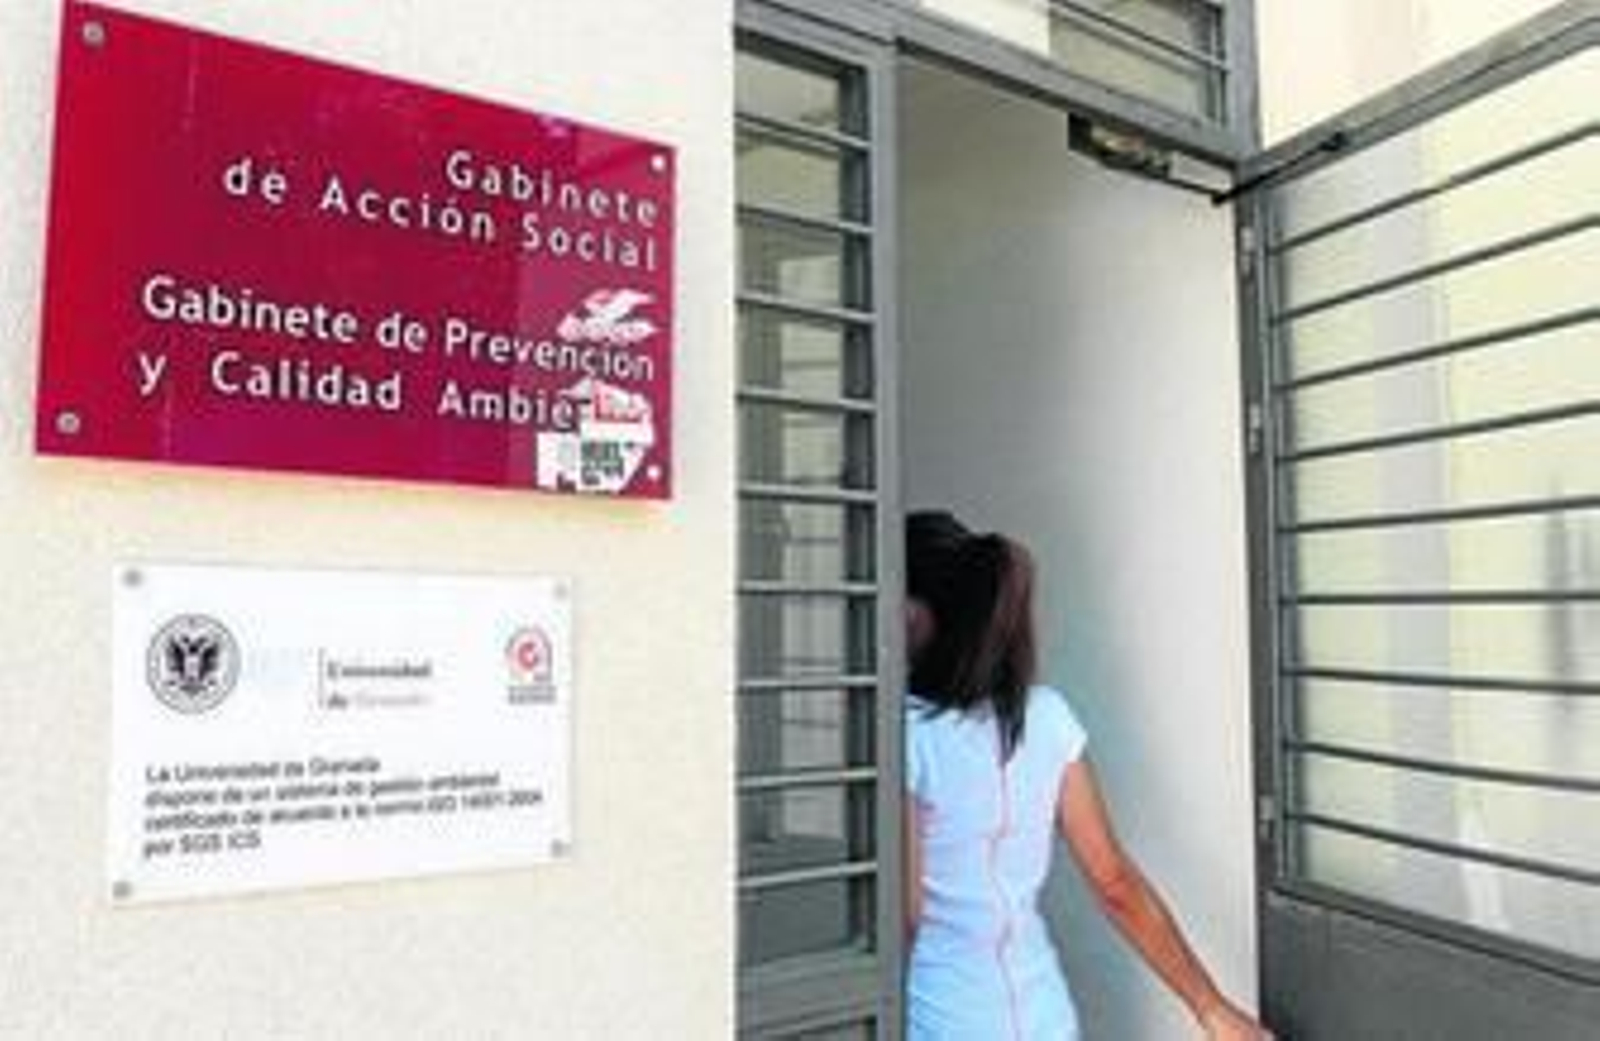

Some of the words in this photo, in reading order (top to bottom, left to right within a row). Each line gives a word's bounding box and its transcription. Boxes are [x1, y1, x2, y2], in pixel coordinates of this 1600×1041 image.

[223, 157, 287, 204] de
[319, 174, 496, 242] Acción
[522, 213, 656, 271] Social
[446, 150, 657, 227] Gabinete
[144, 275, 357, 343] Gabinete
[376, 312, 428, 352] de
[138, 352, 167, 396] y
[211, 351, 400, 410] Calidad
